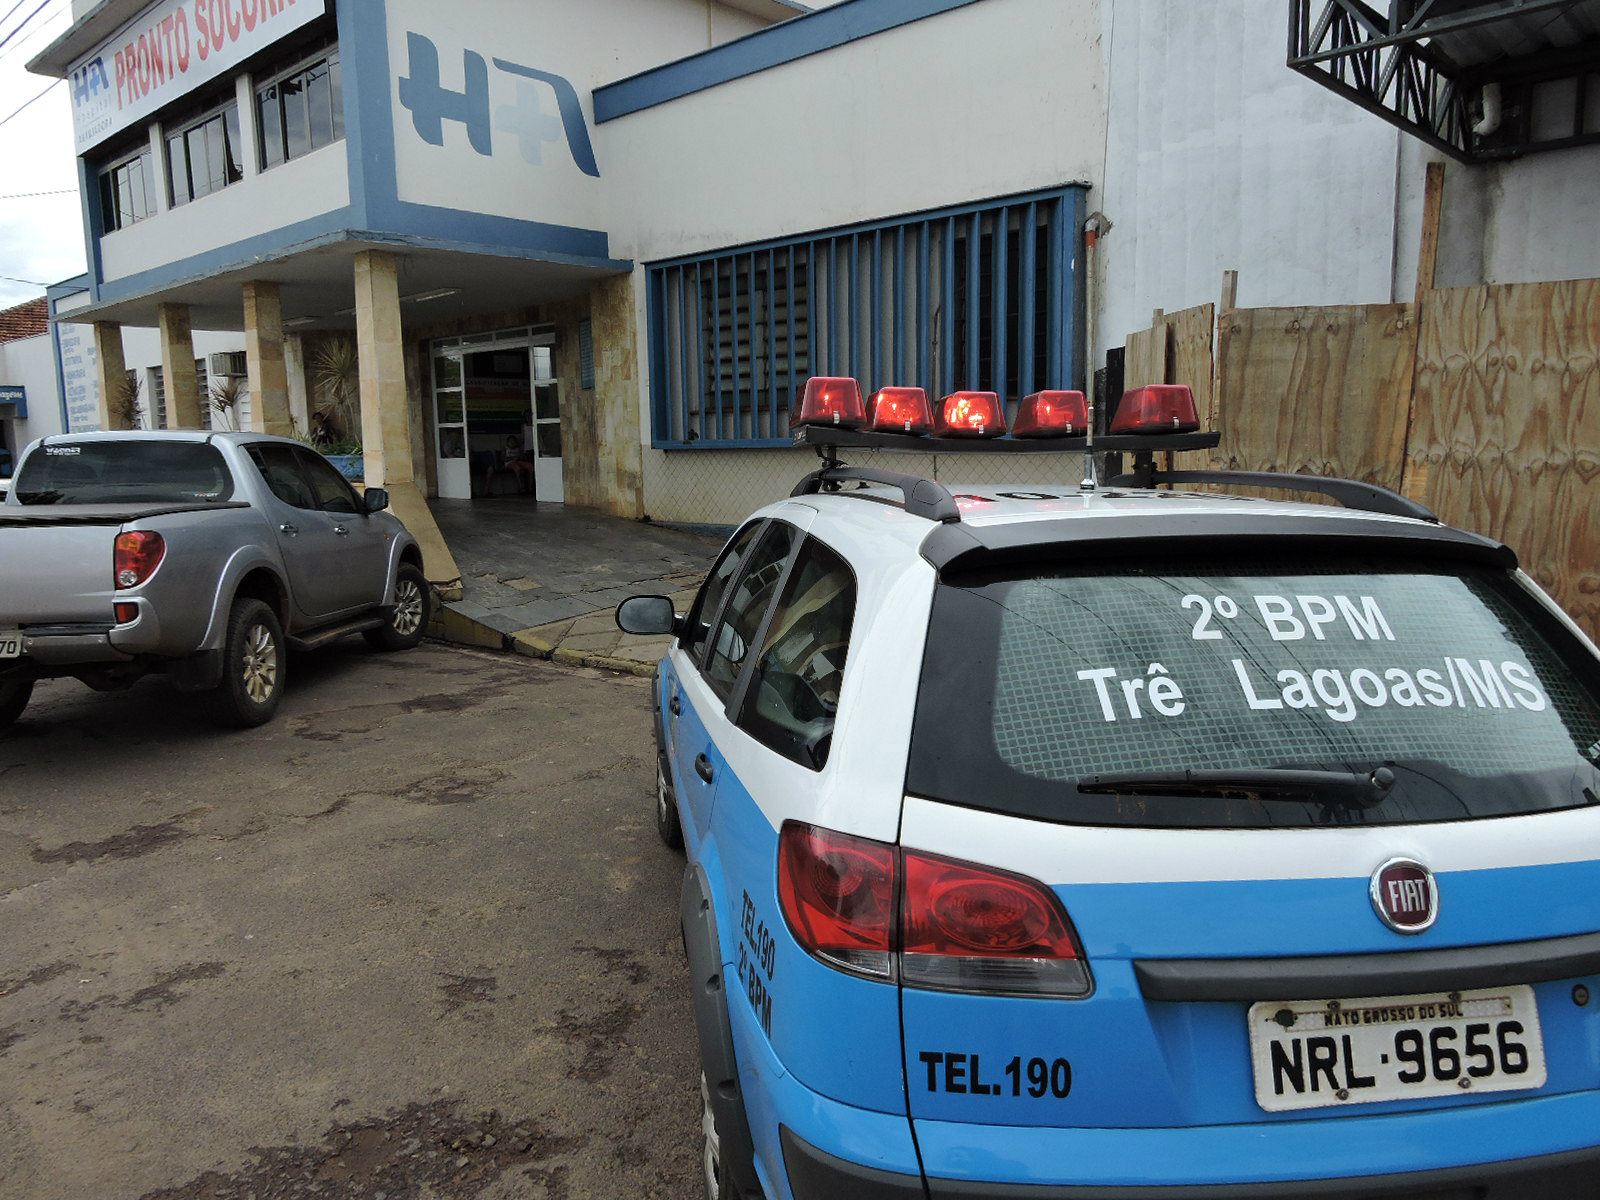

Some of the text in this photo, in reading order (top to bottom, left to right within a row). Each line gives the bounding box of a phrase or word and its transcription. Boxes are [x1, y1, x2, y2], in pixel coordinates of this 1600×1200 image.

[114, 6, 190, 111] PRONTO
[1181, 594, 1395, 641] 2º BPM
[1077, 656, 1546, 722] Trê Lagoas/MS
[1388, 879, 1426, 913] FIAT
[741, 888, 775, 981] TEL.190
[749, 961, 772, 1039] BPM
[1363, 1007, 1415, 1023] GROSSO
[1419, 1006, 1435, 1019] DO
[1439, 1002, 1463, 1017] SUL
[919, 1051, 1072, 1099] TEL.190
